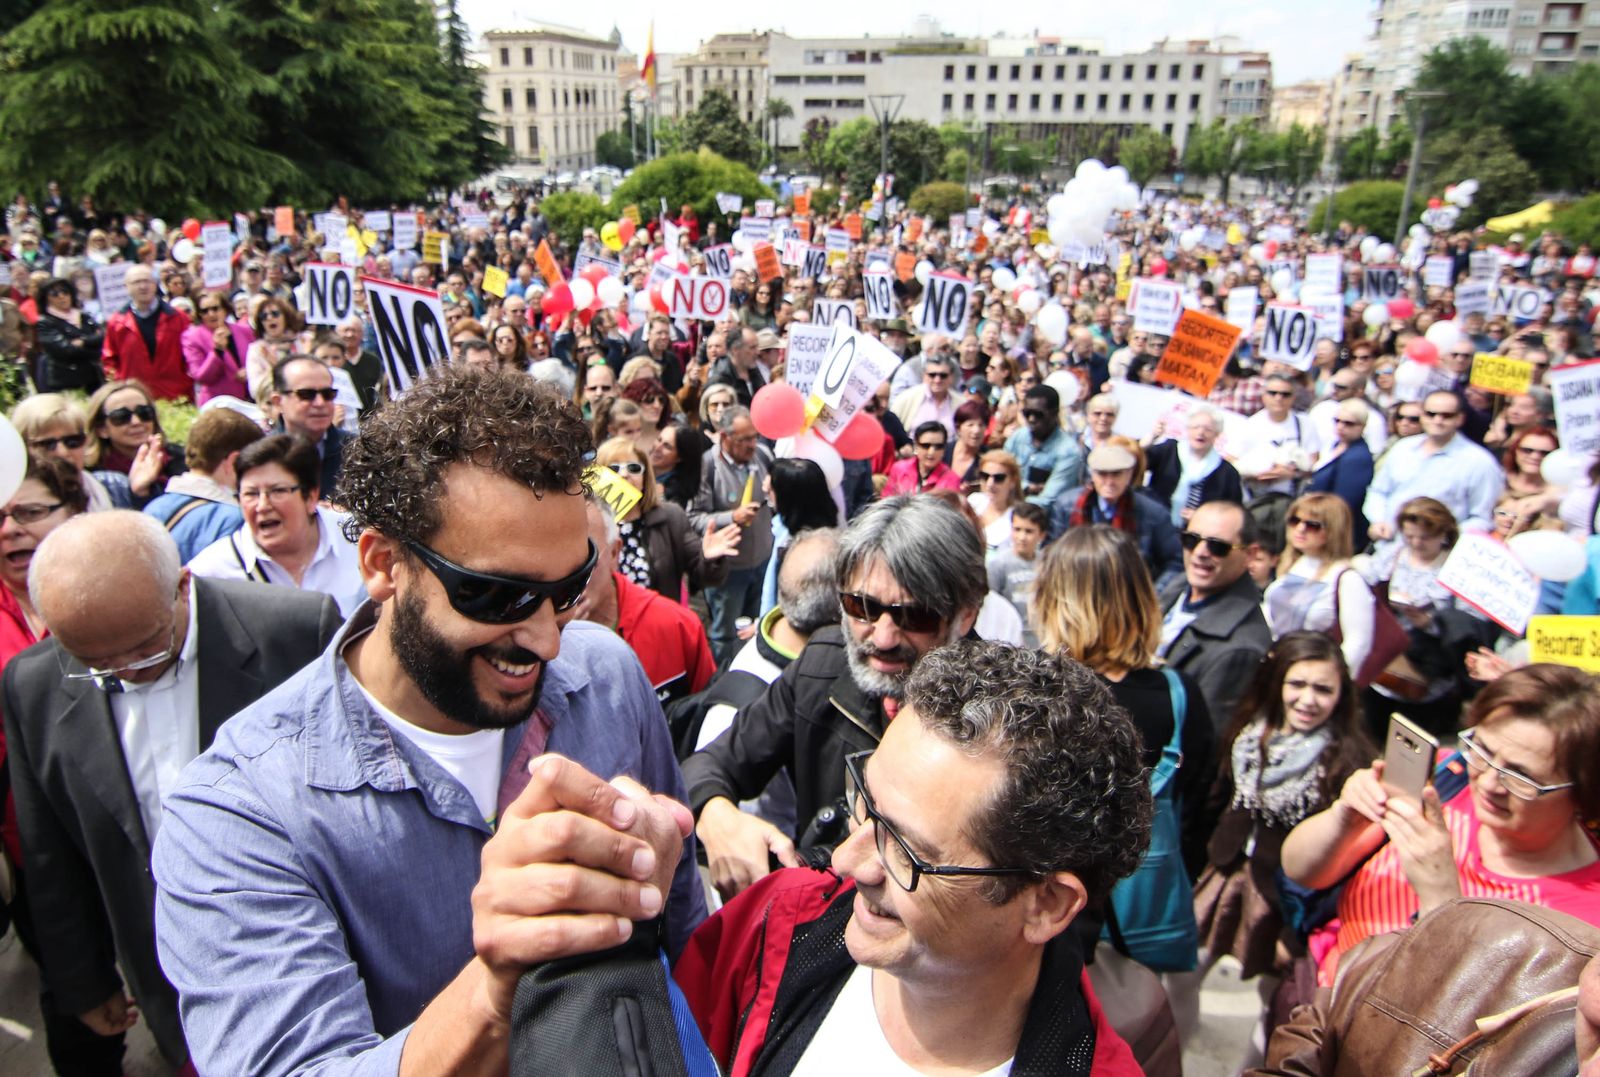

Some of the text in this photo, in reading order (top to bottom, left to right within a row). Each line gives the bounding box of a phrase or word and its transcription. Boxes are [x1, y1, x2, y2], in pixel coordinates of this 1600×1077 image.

[705, 249, 731, 276] NO
[802, 250, 826, 280] NO
[309, 269, 350, 319] NO
[672, 278, 726, 316] NO
[865, 276, 890, 314] NO
[1367, 270, 1398, 297] NO
[922, 278, 967, 332] NO
[1494, 288, 1540, 315] NO
[370, 290, 449, 392] NO
[1263, 308, 1306, 354] NO
[790, 358, 801, 374] EN
[1161, 358, 1208, 386] MATAN
[597, 483, 633, 516] AN
[1536, 629, 1586, 656] Recortar
